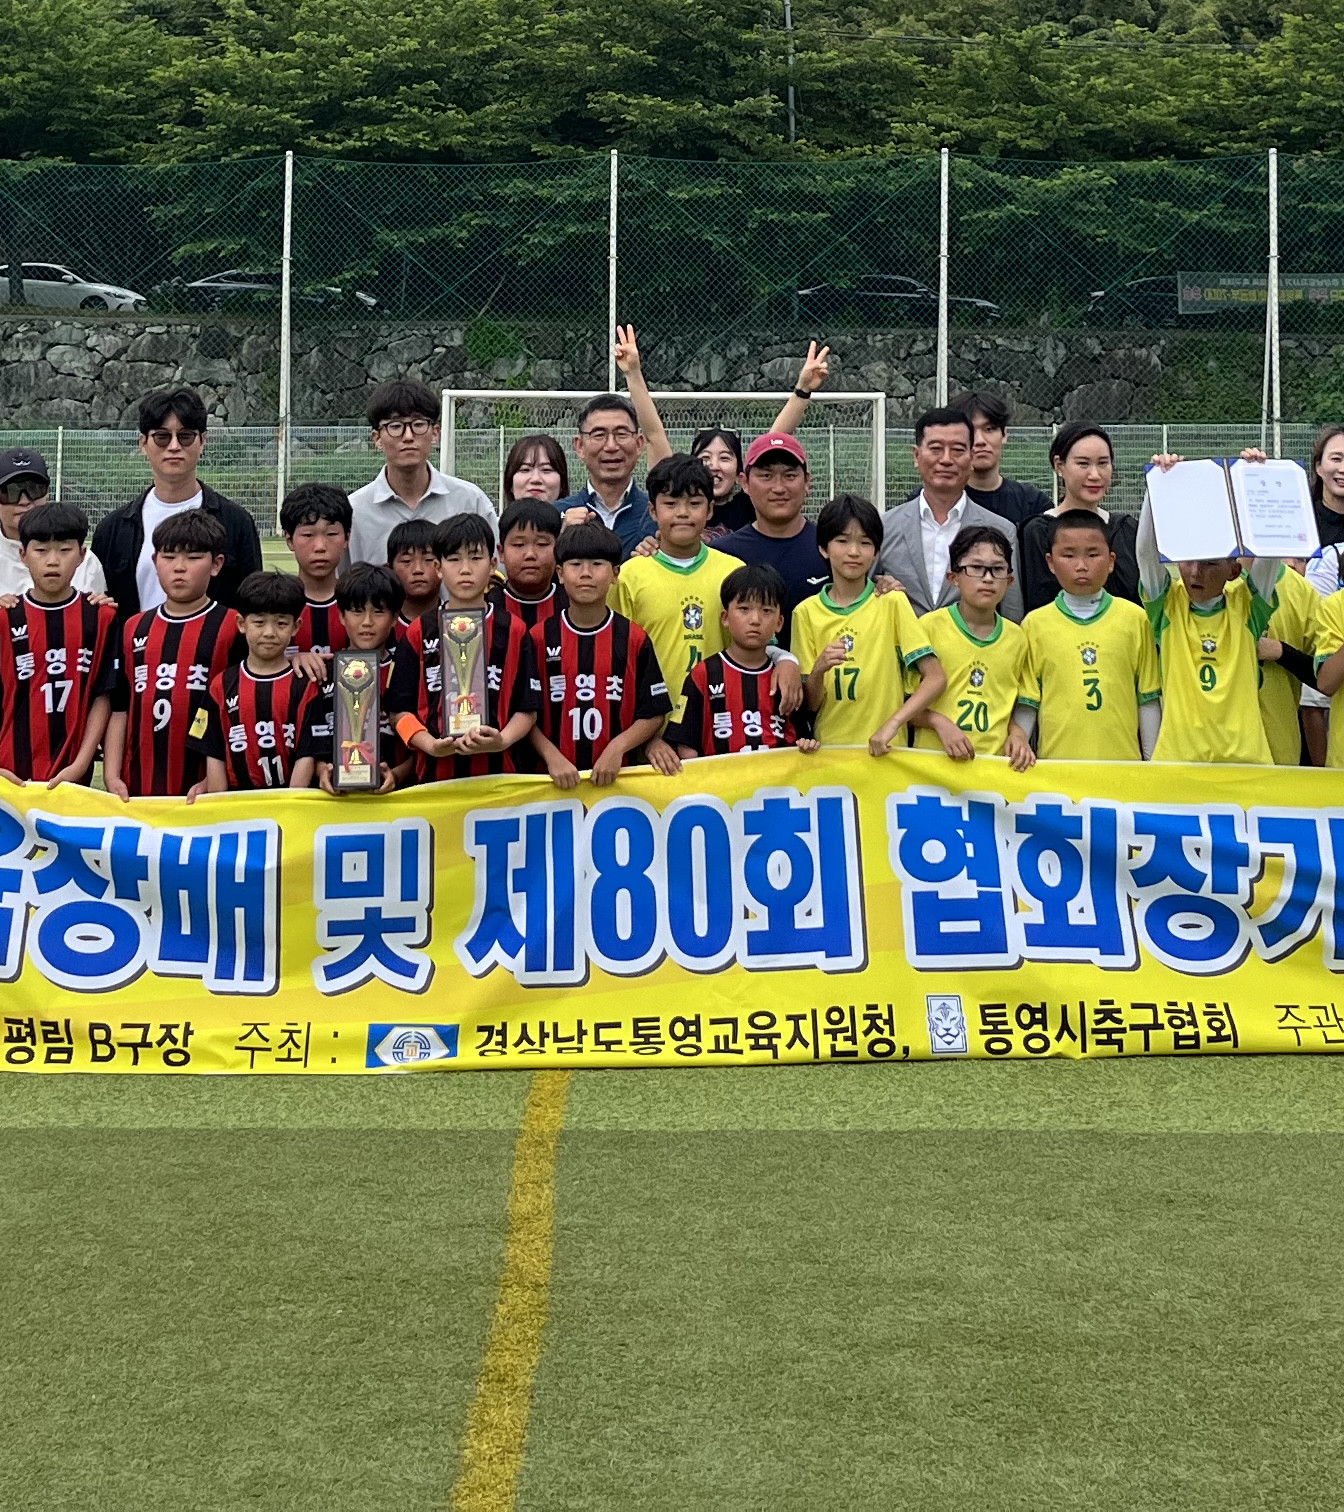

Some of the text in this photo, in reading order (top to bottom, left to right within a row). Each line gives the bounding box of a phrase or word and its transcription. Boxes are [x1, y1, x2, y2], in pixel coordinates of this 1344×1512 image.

[16, 647, 93, 681] 통영초
[134, 663, 209, 693] 통영초
[1199, 663, 1217, 692] 9
[40, 679, 73, 713] 17
[549, 674, 623, 702] 통영초
[834, 667, 860, 701] 17
[1083, 678, 1103, 711] 3
[152, 698, 172, 732] 9
[568, 707, 603, 741] 10
[713, 710, 786, 739] 통영초
[956, 699, 989, 733] 20
[228, 720, 296, 753] 통영초
[257, 754, 286, 786] 11
[315, 819, 429, 991] 및
[459, 788, 859, 982] 제80회
[2, 1016, 74, 1066] 평림
[89, 1021, 195, 1067] B구장
[234, 1021, 311, 1069] 주최
[978, 999, 1240, 1056] 통영시축구협회
